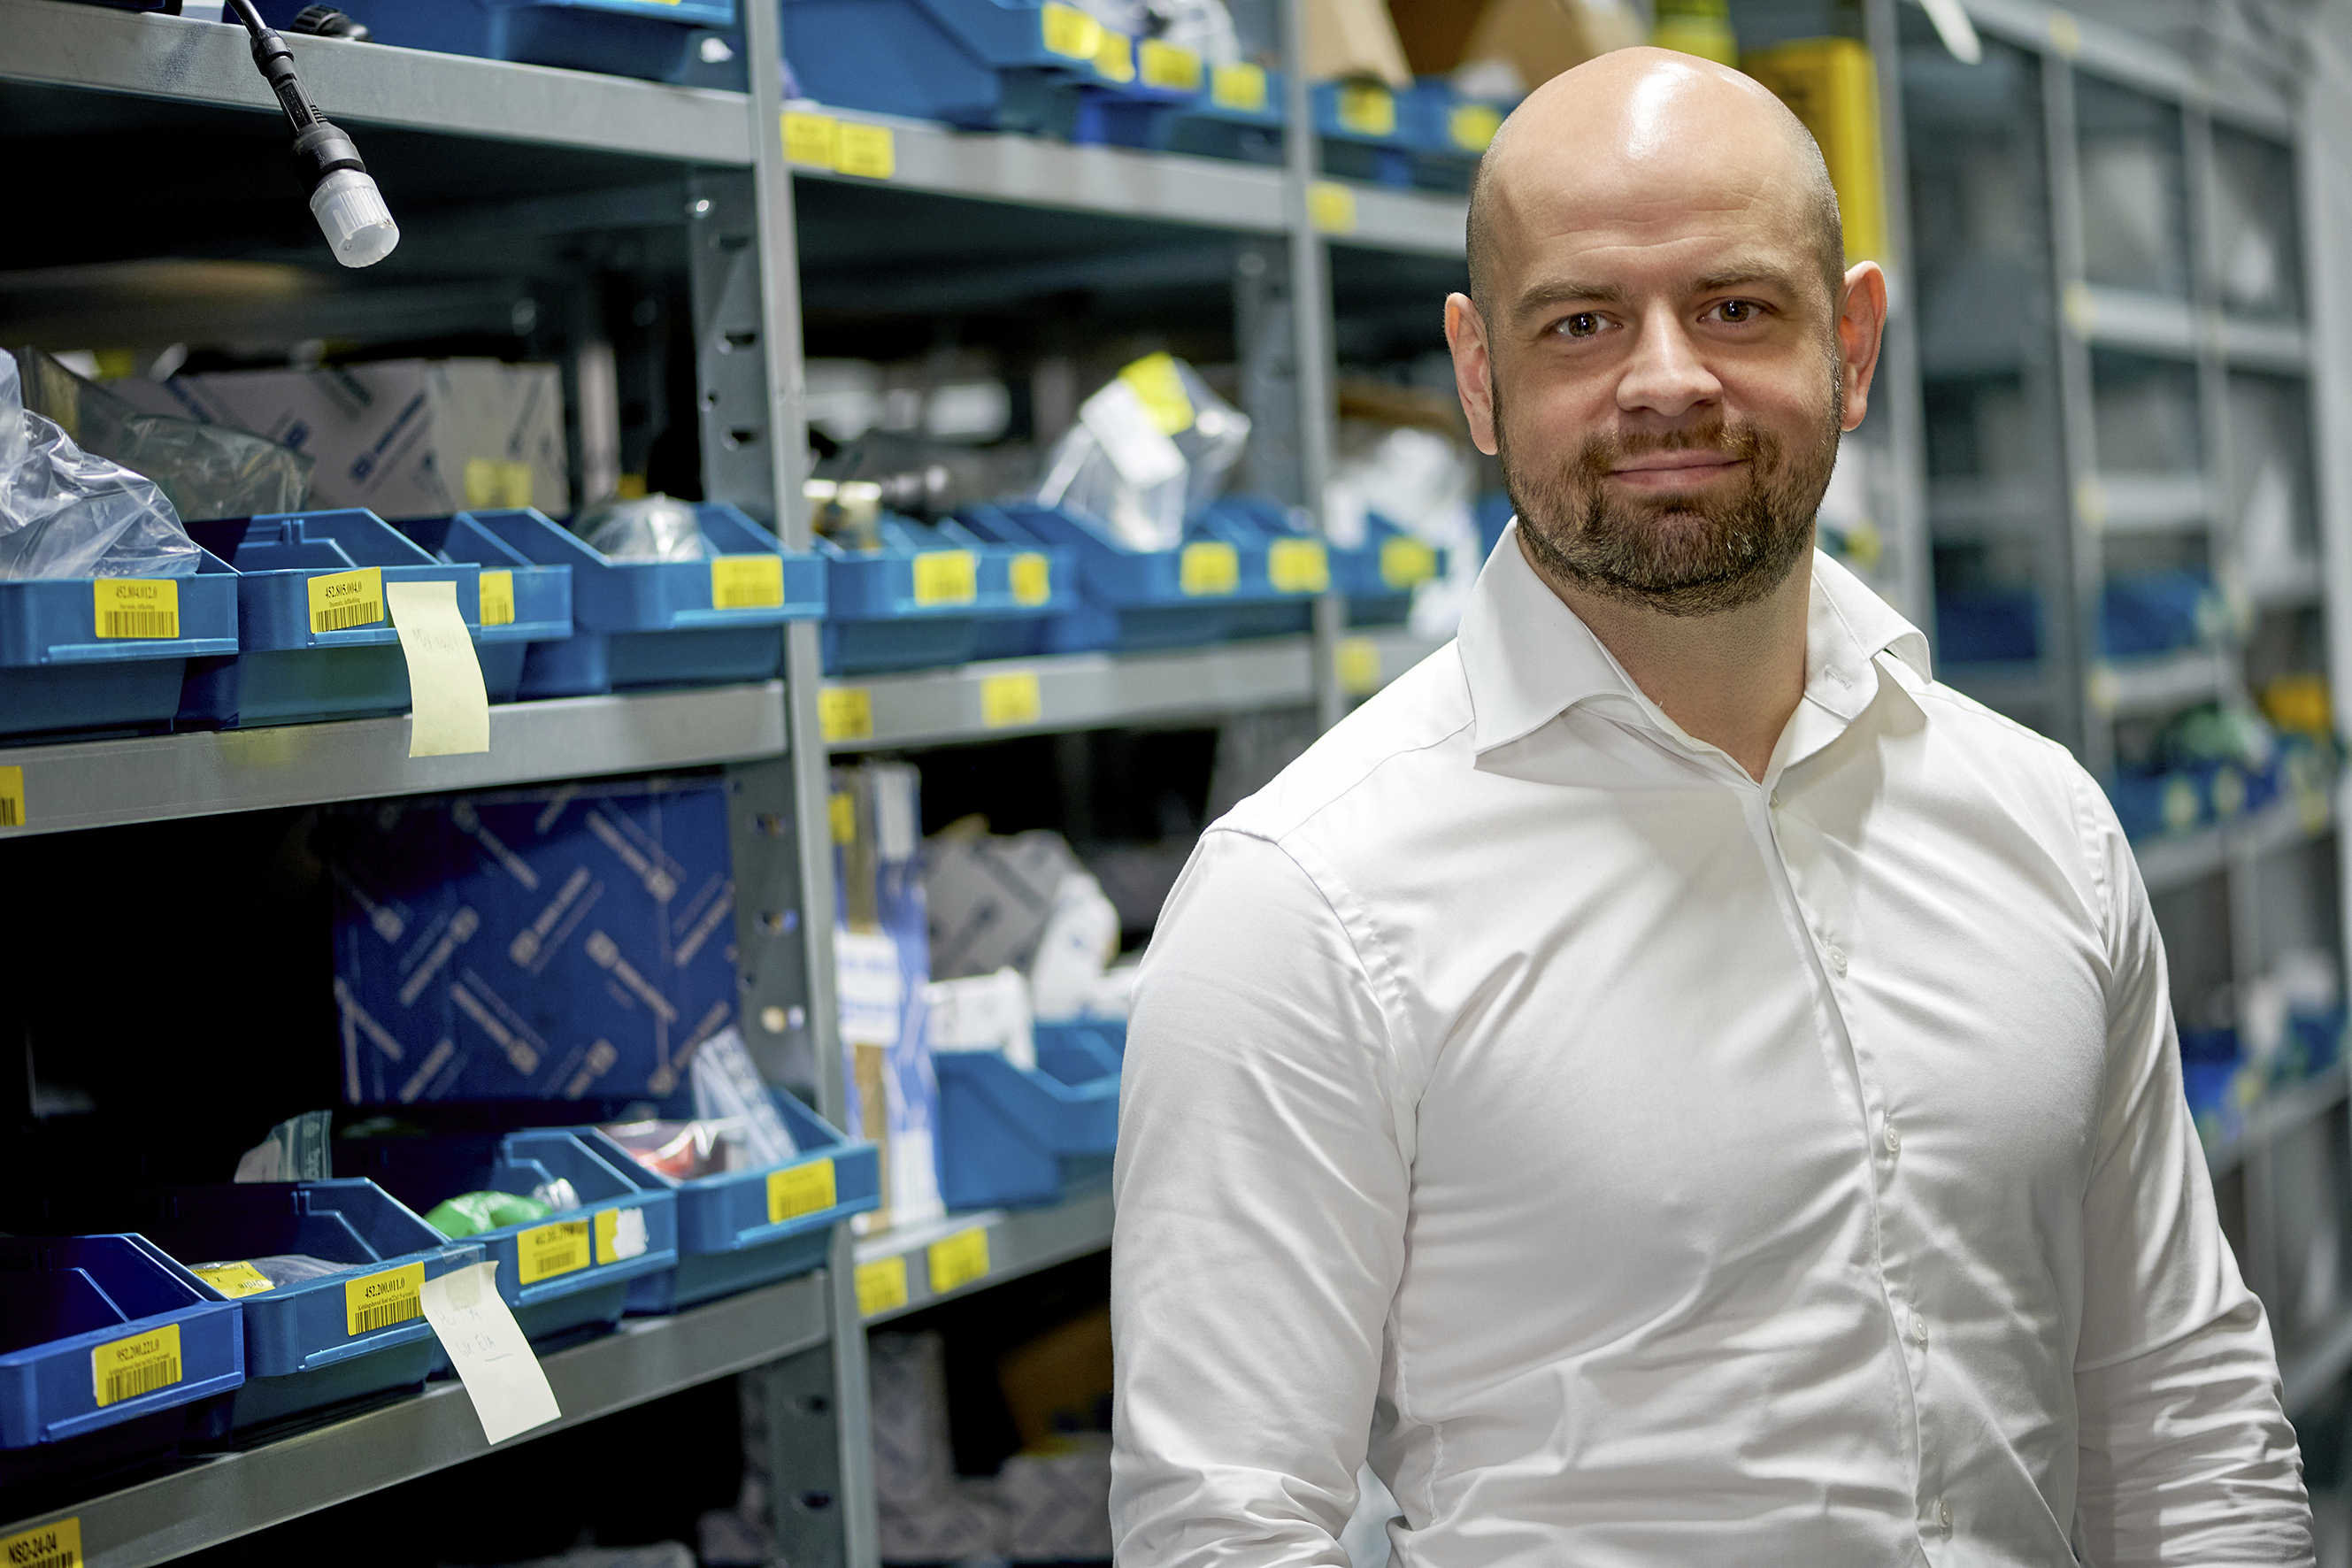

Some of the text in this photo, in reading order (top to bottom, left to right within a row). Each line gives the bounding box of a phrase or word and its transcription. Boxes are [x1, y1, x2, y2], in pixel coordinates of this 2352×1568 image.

[326, 580, 362, 598] 452.805.004.0
[237, 1280, 264, 1289] Ordre
[365, 1277, 404, 1298] 452.200.011.0
